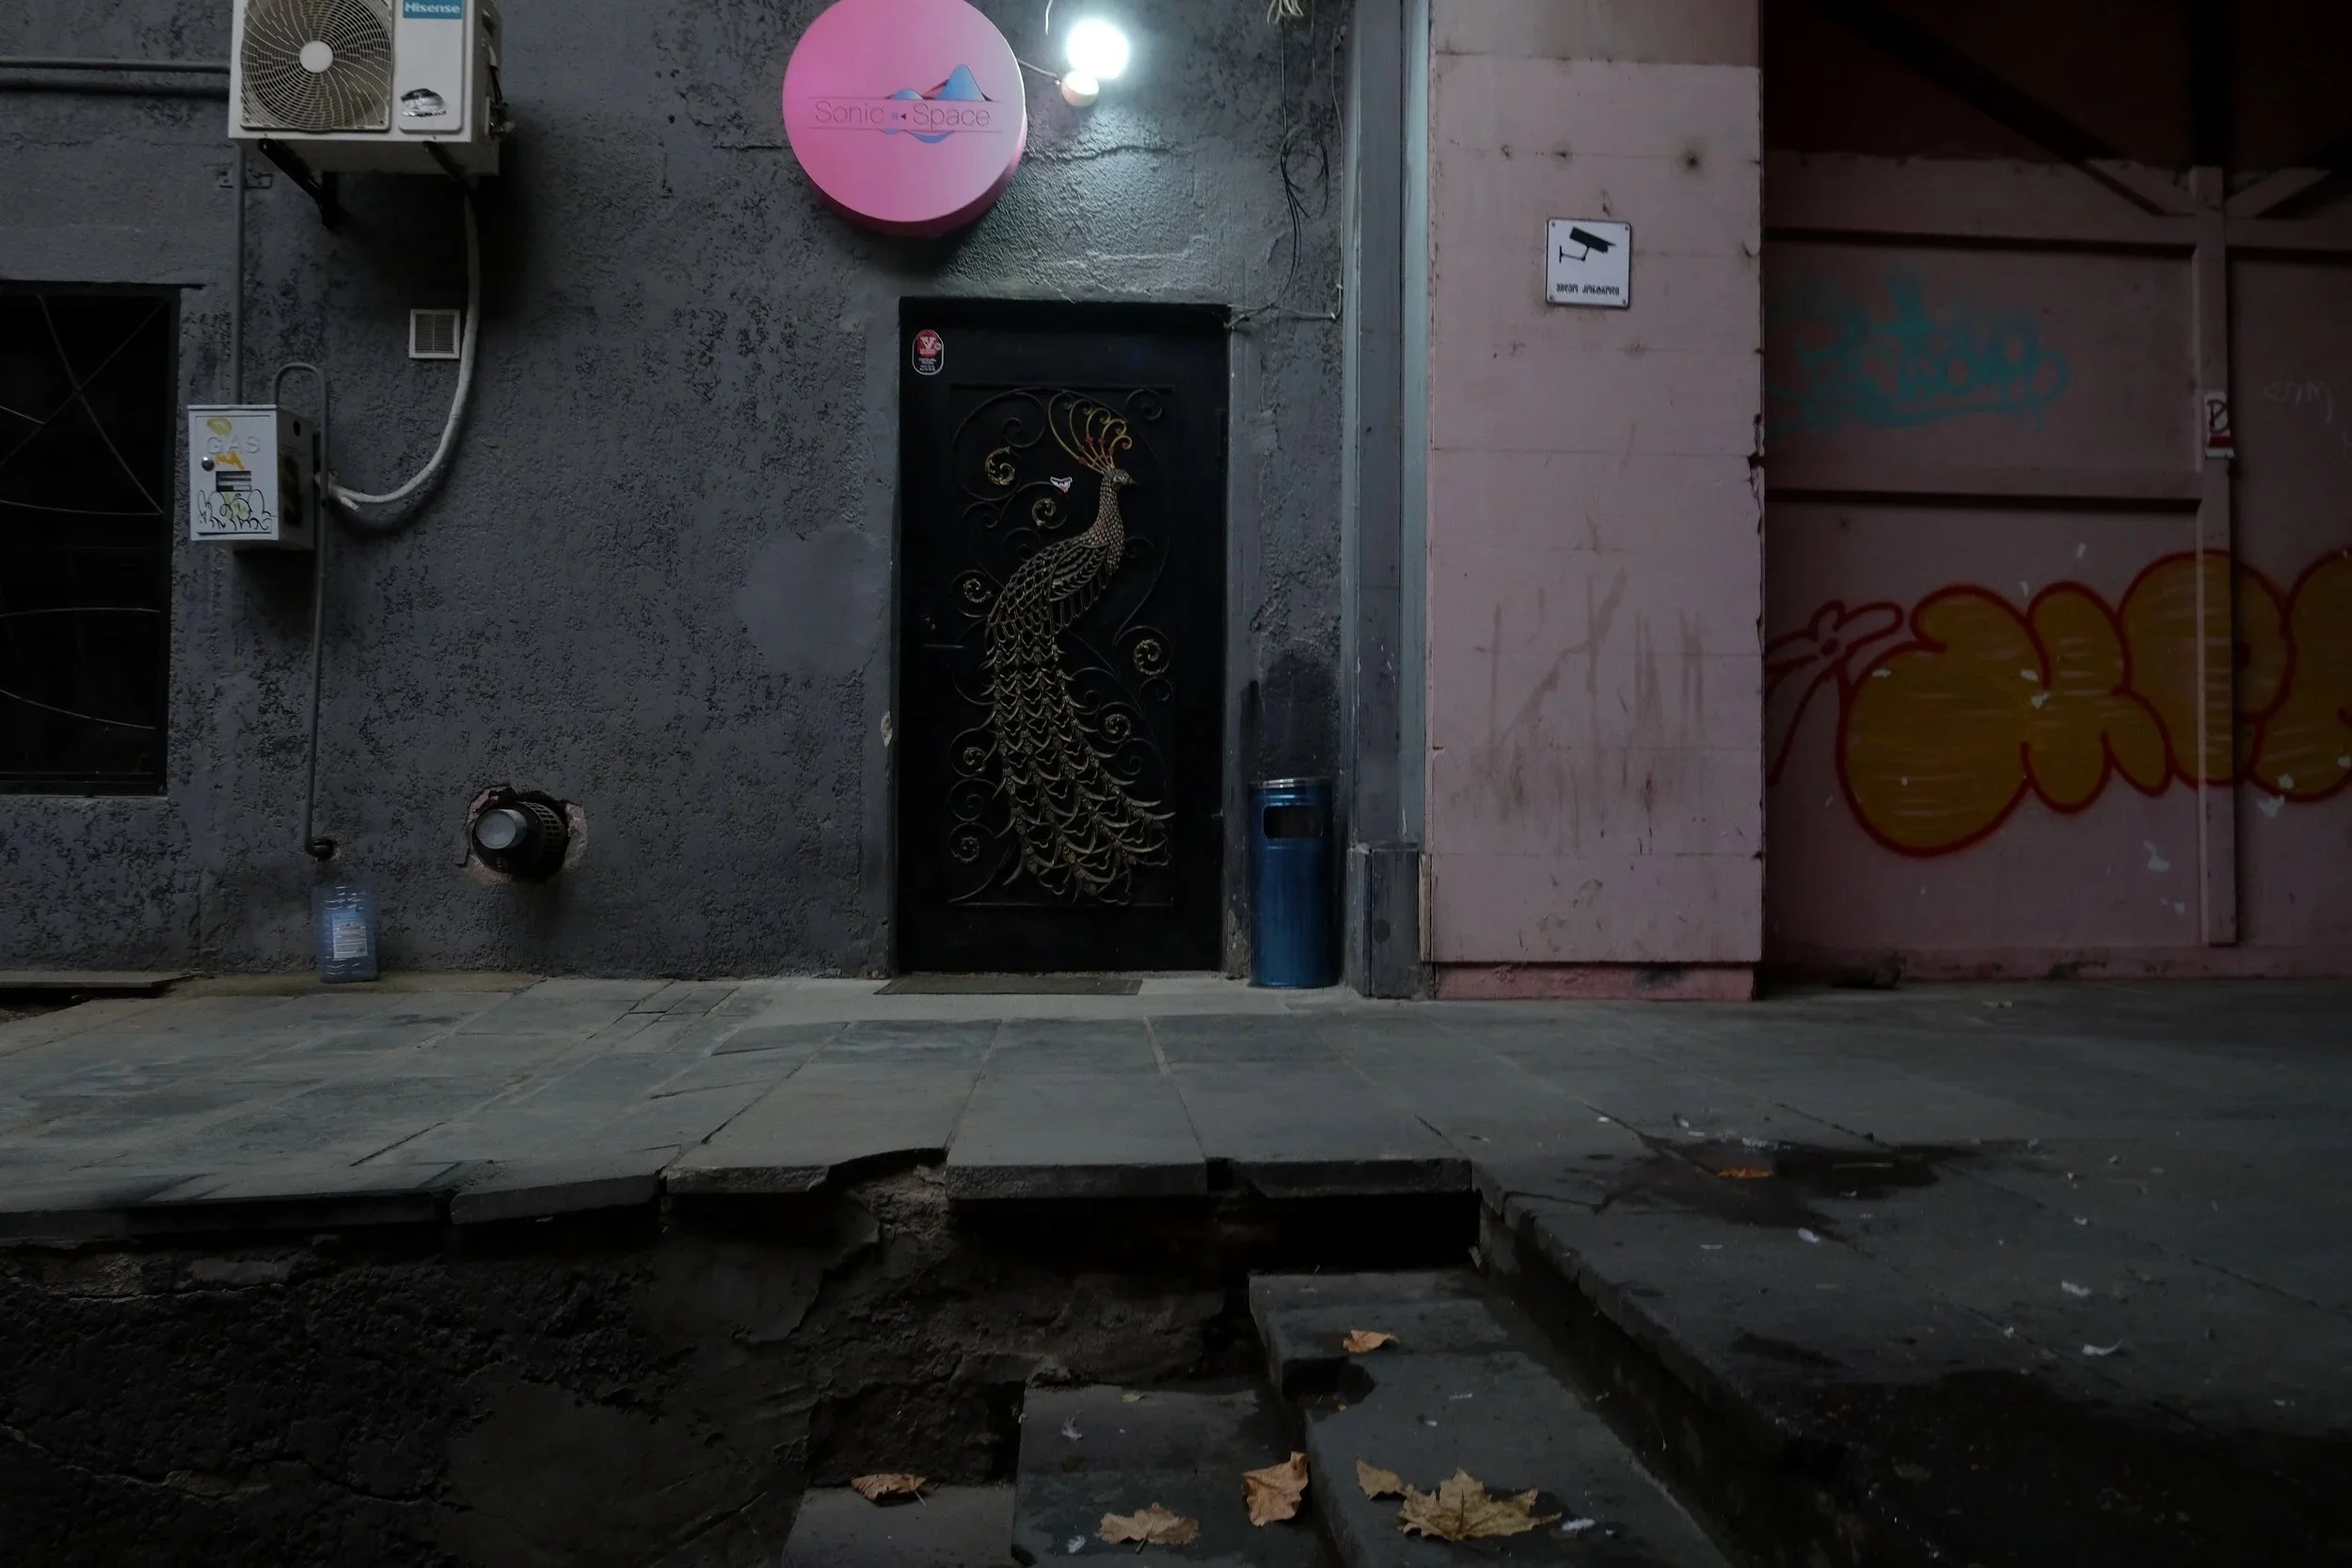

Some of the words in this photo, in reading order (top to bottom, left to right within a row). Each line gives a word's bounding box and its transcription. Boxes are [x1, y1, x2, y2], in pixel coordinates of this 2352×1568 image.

[405, 1, 461, 13] Hisense
[815, 100, 884, 124] Sonic
[913, 103, 991, 130] Space
[206, 436, 260, 454] GAS
